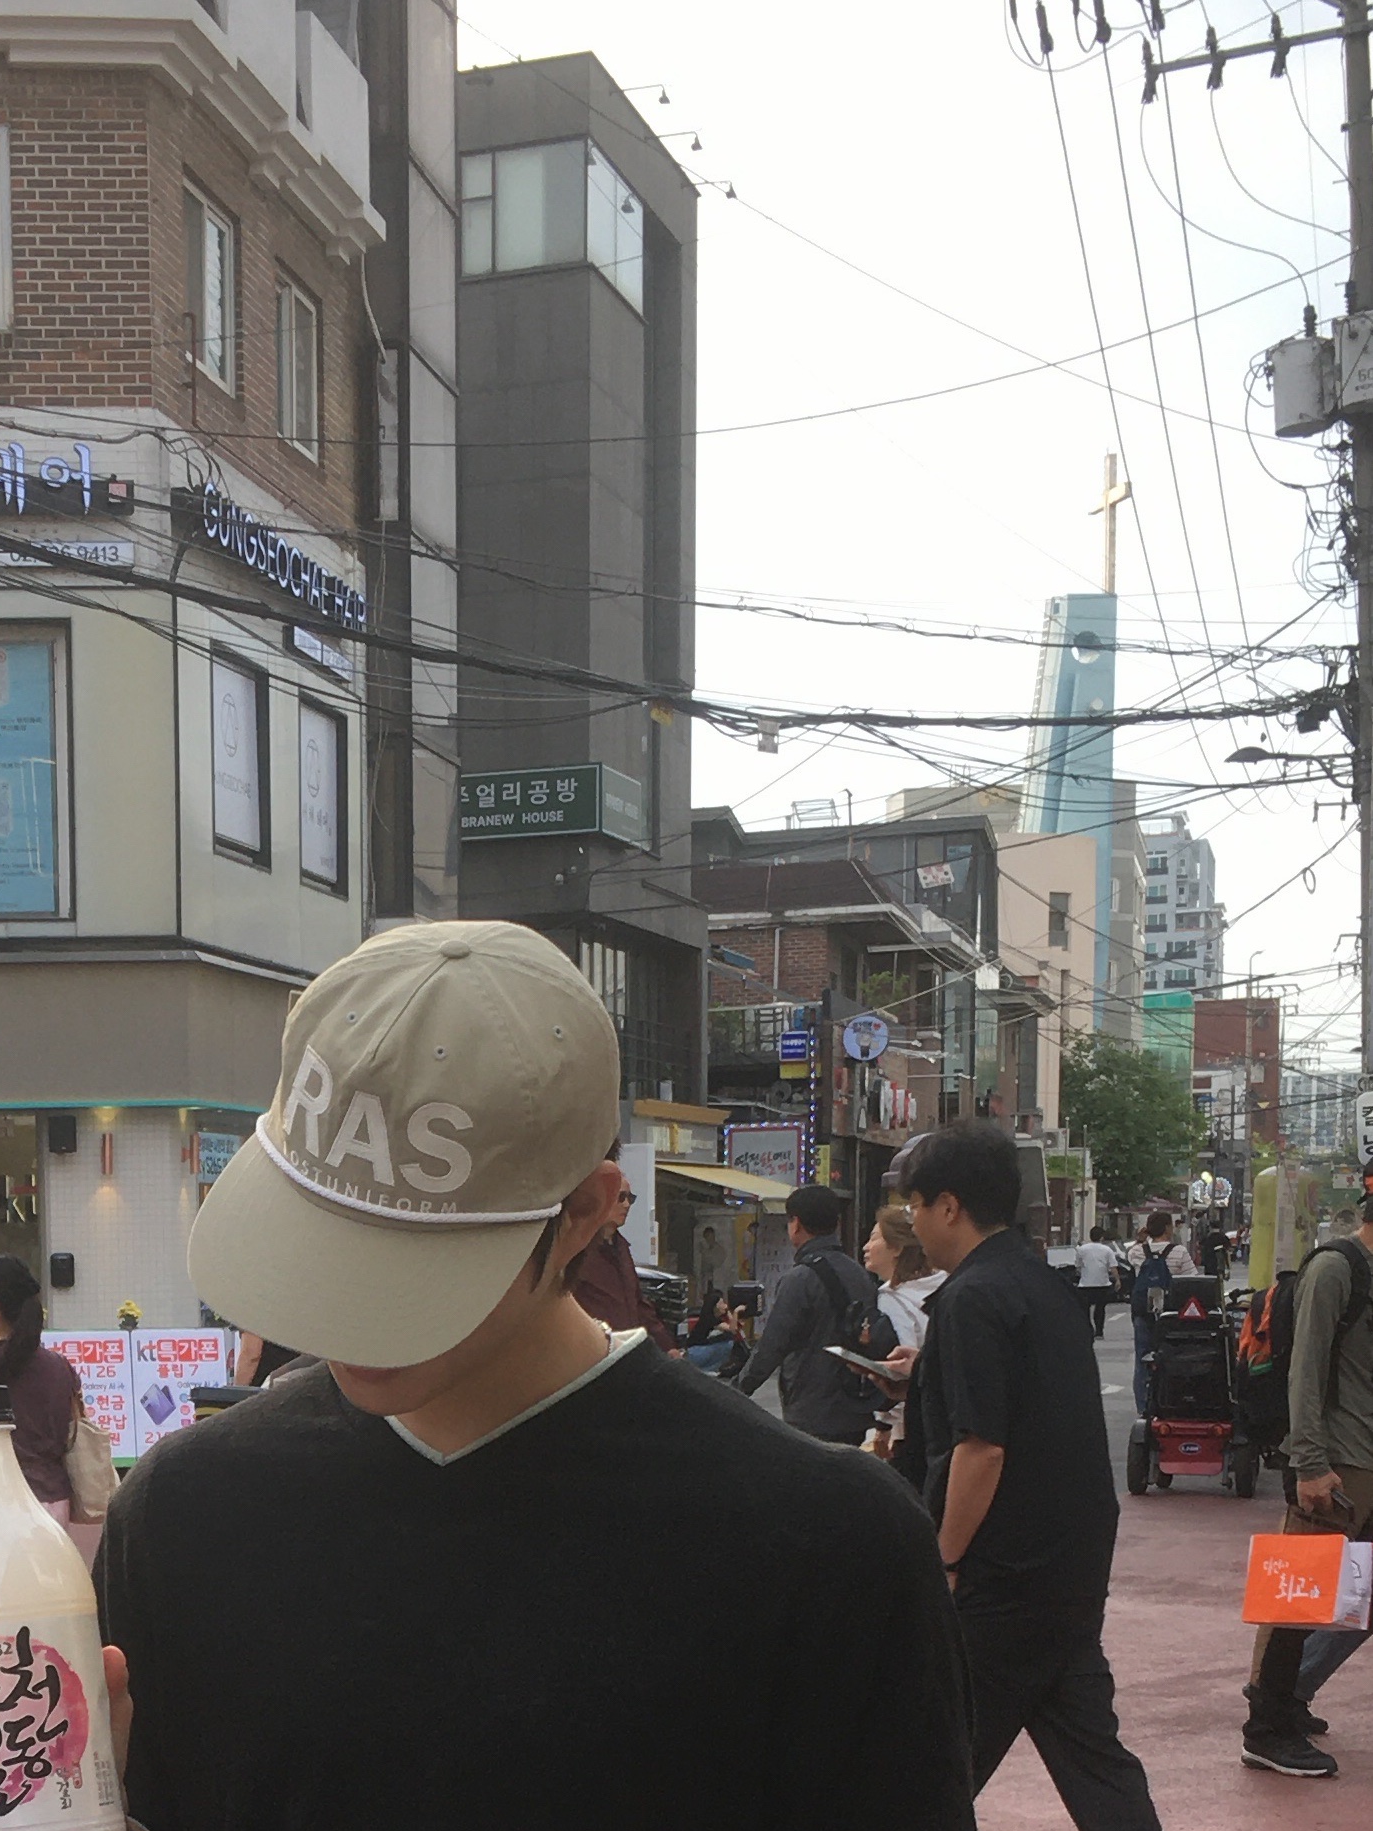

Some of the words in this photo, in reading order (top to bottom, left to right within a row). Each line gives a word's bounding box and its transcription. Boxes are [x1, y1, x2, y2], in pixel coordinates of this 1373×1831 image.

[522, 810, 564, 825] HOUSE
[283, 1044, 474, 1194] RAS
[96, 1365, 117, 1378] 26
[157, 1364, 184, 1378] 플립
[188, 1364, 199, 1377] 7
[96, 1395, 125, 1411] 현금
[98, 1414, 127, 1430] 완납
